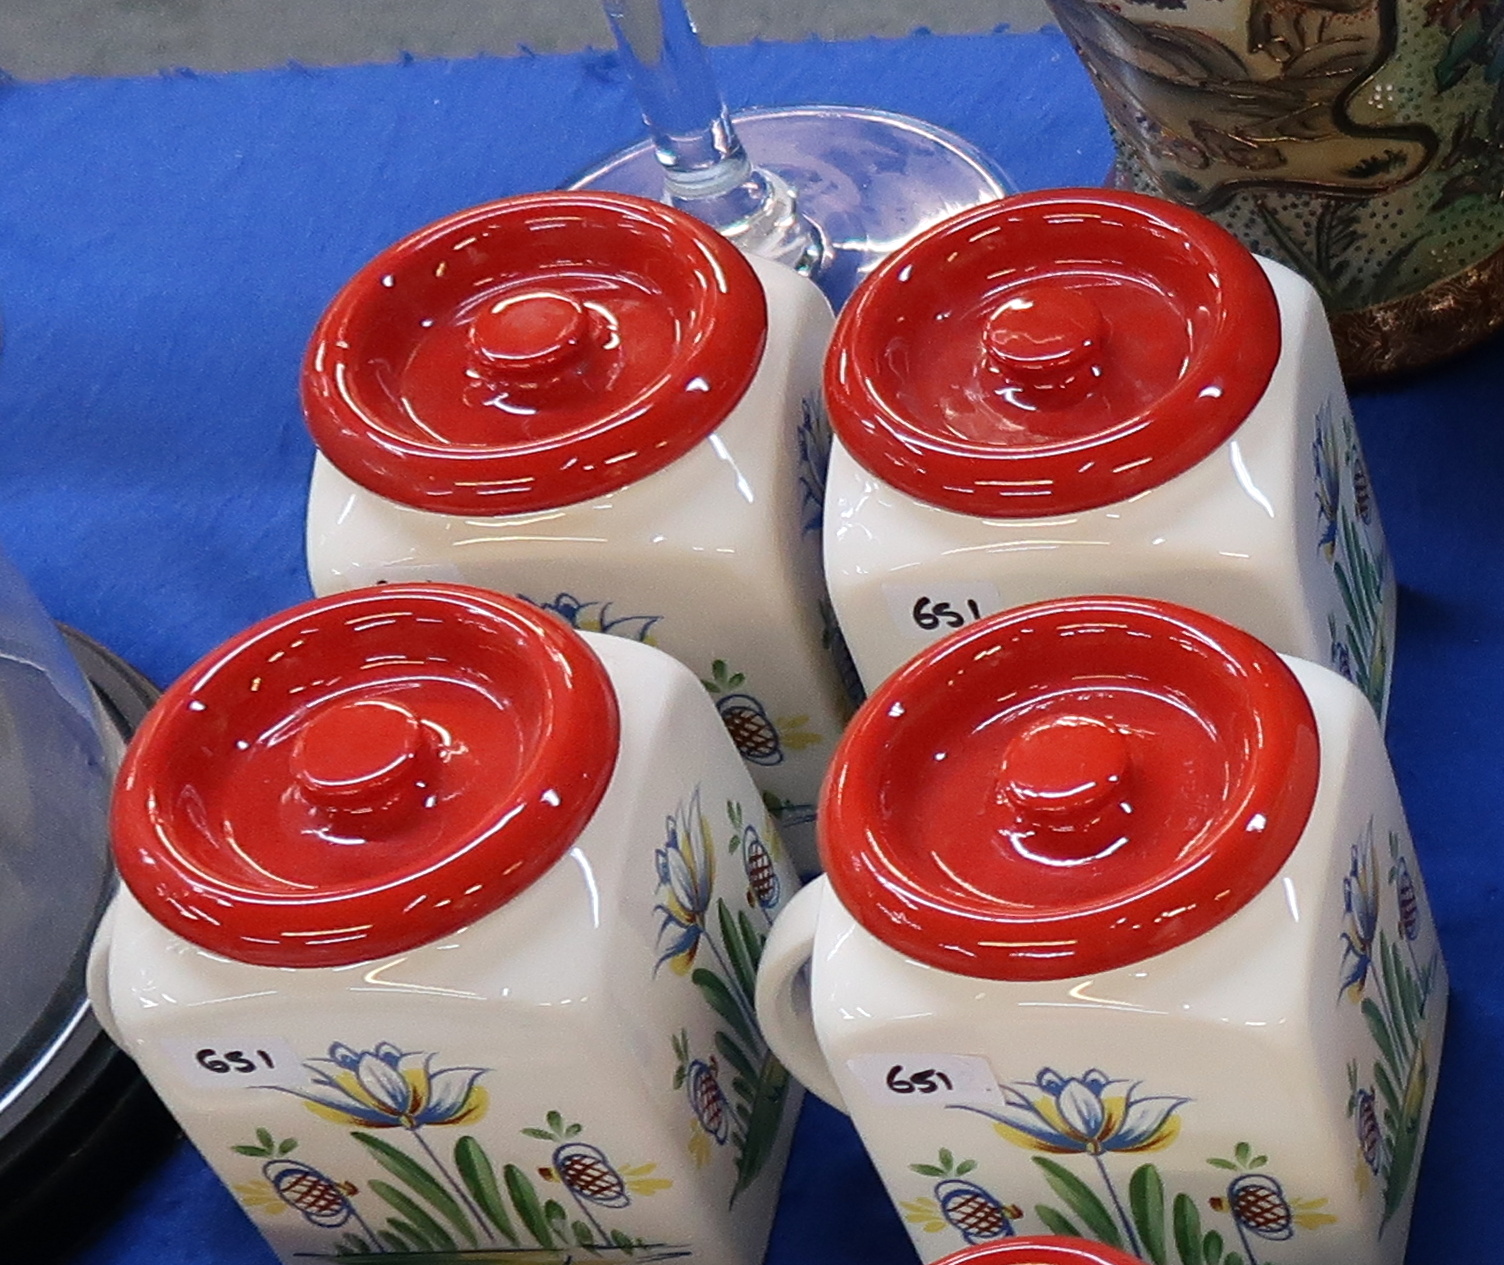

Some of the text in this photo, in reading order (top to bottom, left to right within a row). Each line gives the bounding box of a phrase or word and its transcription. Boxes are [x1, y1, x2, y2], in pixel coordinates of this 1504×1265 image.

[912, 596, 981, 631] 651
[195, 1048, 275, 1074] 651
[886, 1064, 953, 1094] 651
